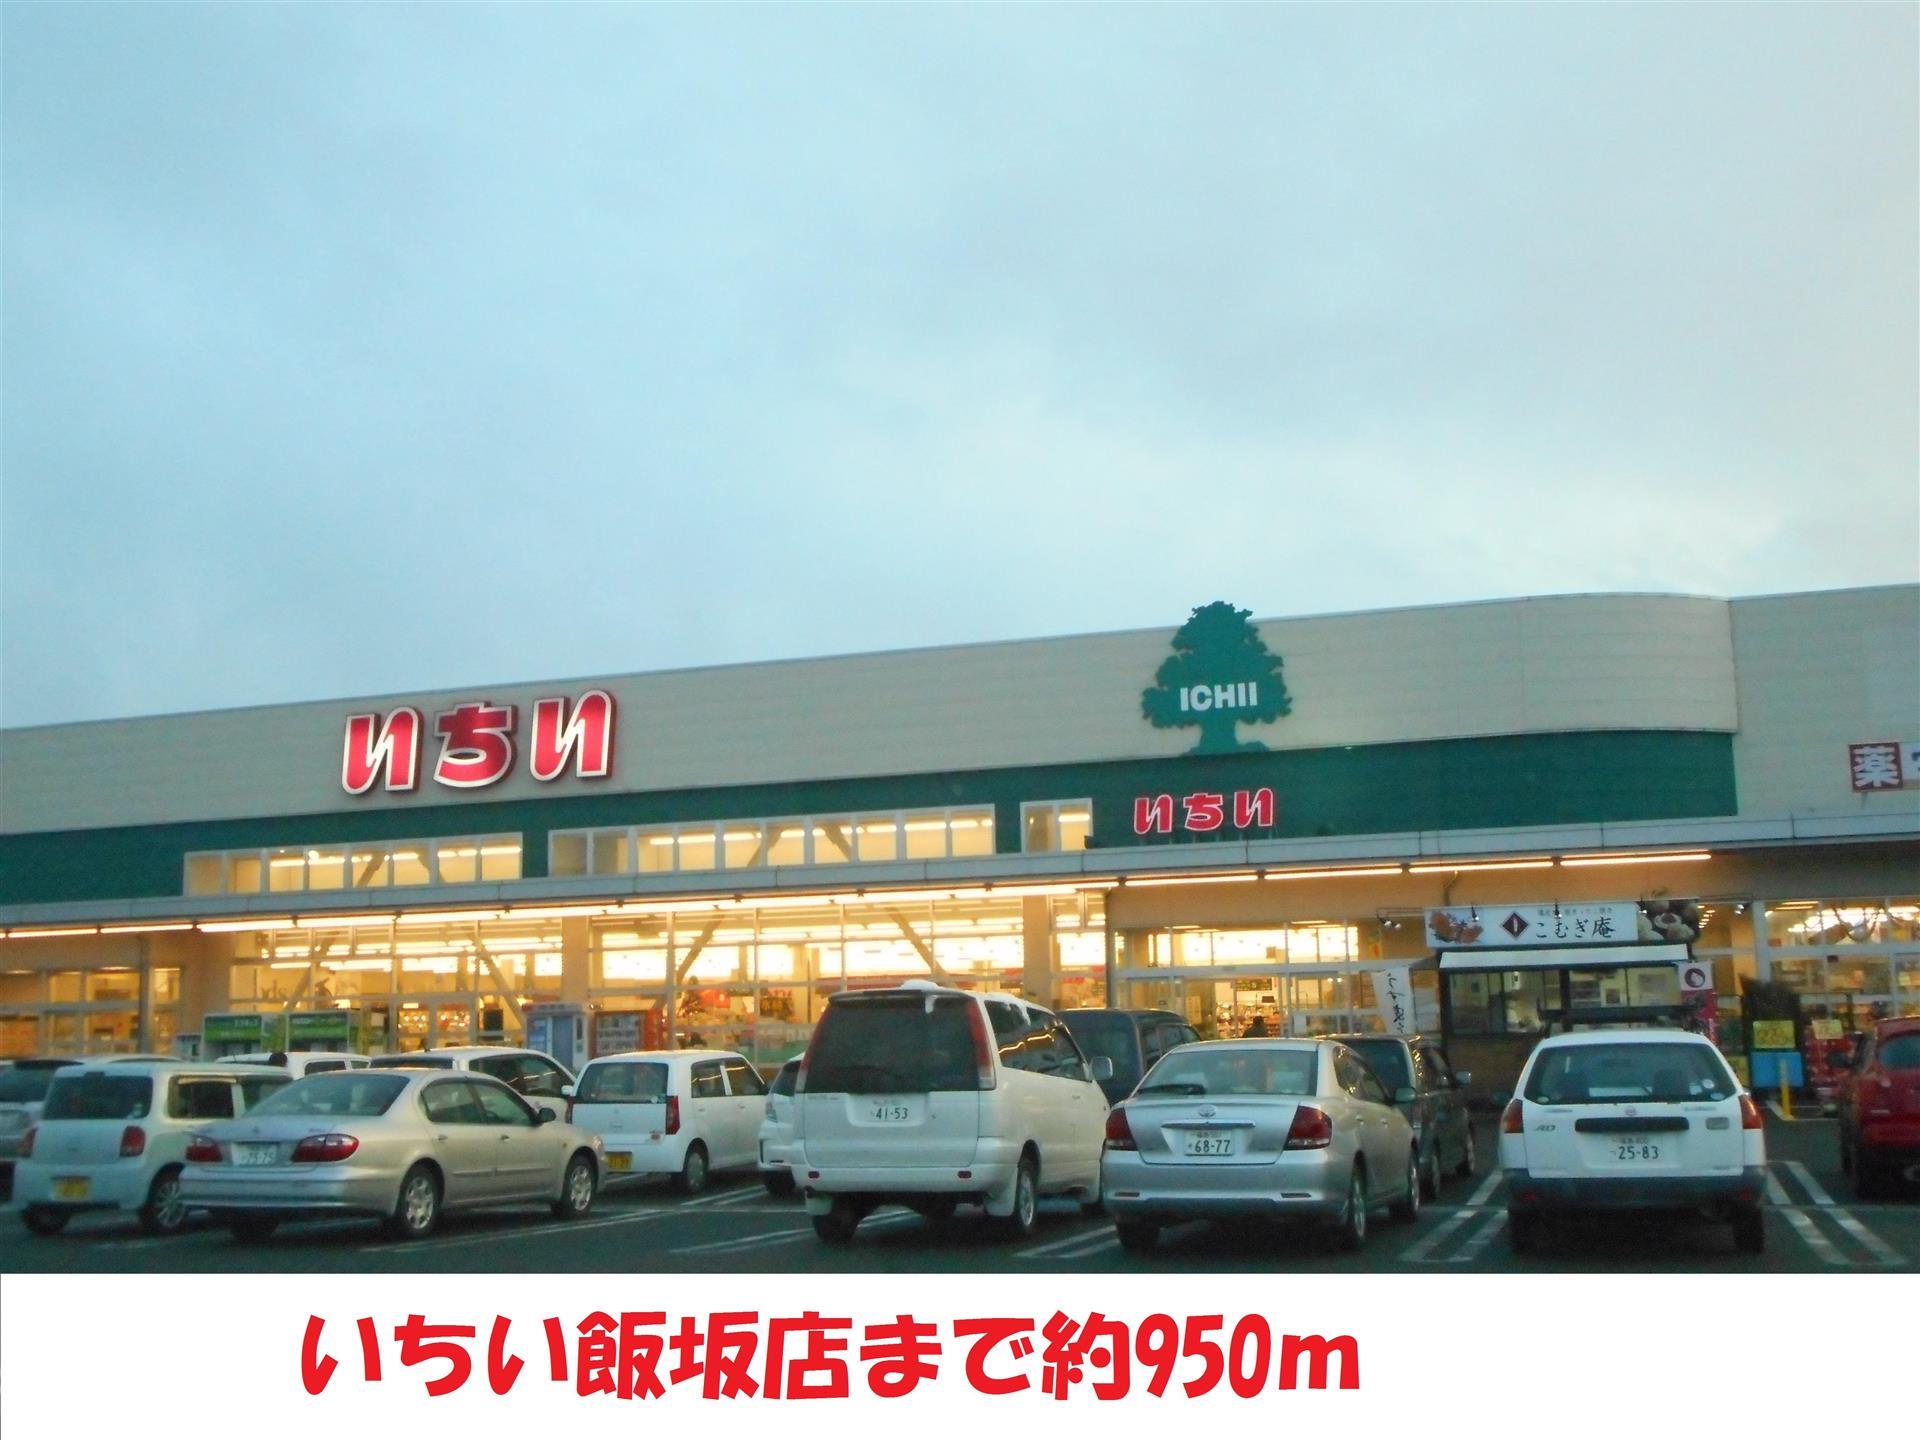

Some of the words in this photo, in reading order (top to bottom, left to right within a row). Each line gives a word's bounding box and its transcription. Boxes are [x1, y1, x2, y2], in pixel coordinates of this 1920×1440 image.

[1180, 682, 1258, 711] ICHII
[341, 690, 617, 795] いちい
[1133, 788, 1274, 834] いちい
[1537, 916, 1617, 939] こむぎ庵
[1194, 1139, 1231, 1153] 68-77
[1618, 1146, 1659, 1160] 25-83
